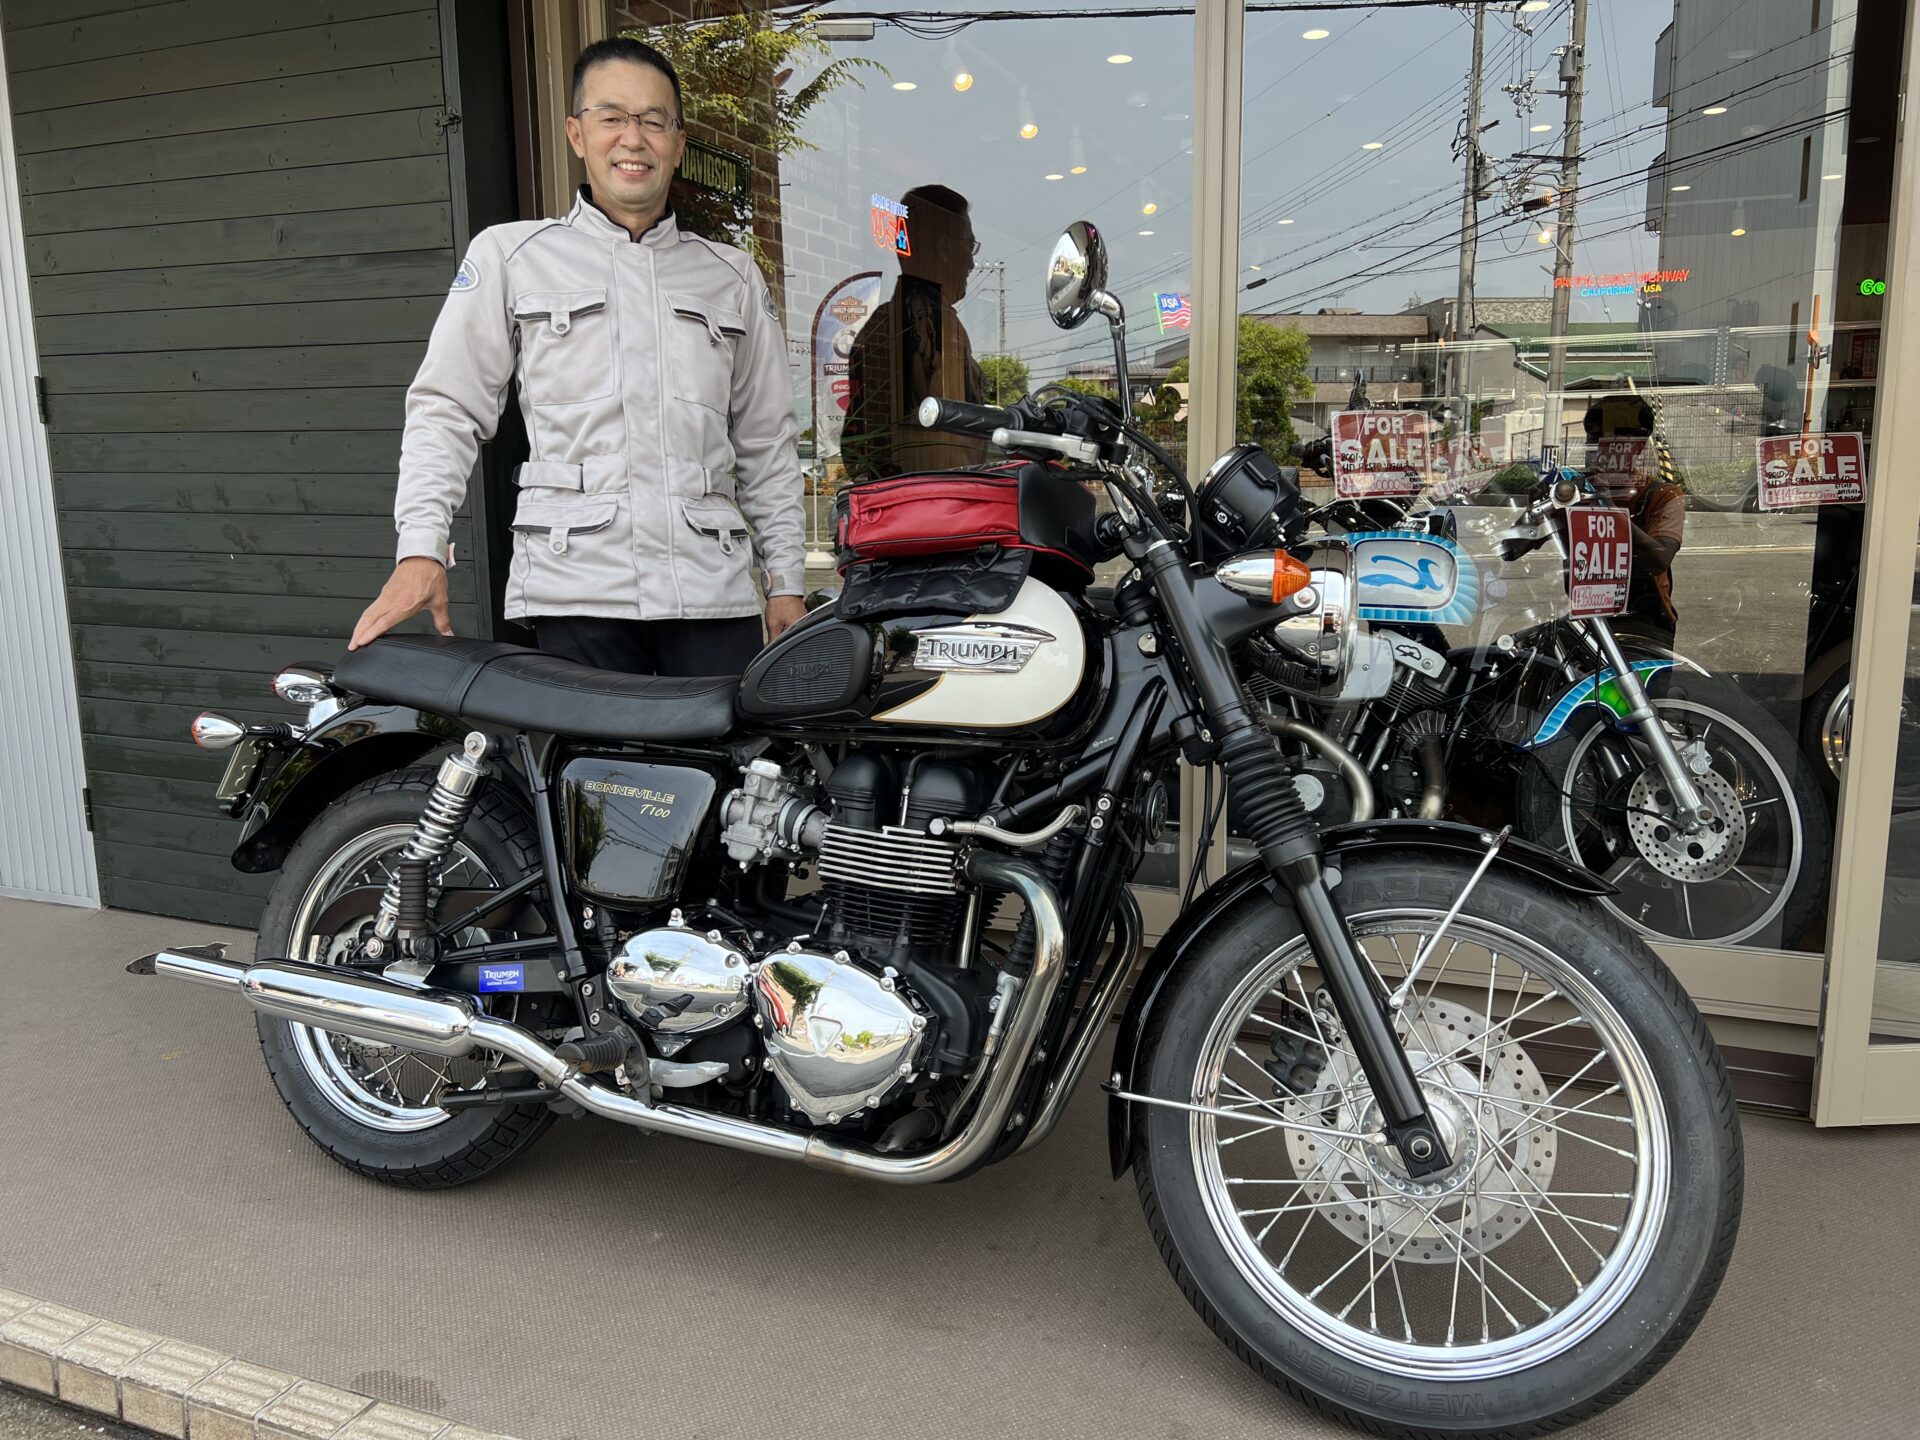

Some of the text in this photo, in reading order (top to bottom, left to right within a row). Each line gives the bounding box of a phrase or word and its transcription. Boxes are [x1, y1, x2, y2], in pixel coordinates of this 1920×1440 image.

[681, 146, 737, 196] DAVIDSON
[871, 207, 911, 256] USA
[1554, 269, 1690, 289] PACIFIC COAST HIGHWAY
[1581, 284, 1662, 297] CALIFORNIA USA
[1161, 297, 1179, 308] USA
[824, 364, 849, 374] TRIUM
[1363, 416, 1405, 435] FOR
[1340, 437, 1426, 471] SALE
[1608, 442, 1632, 454] FOR
[1789, 439, 1834, 457] FOR
[1765, 455, 1859, 485] SALE
[1588, 515, 1616, 538] FOR
[1574, 541, 1629, 581] SALE
[926, 638, 1019, 665] TRIUMPH
[584, 780, 675, 805] BONNEVILLE
[640, 803, 671, 818] T100
[484, 969, 520, 981] TRIUMPH
[1281, 1340, 1486, 1418] METZELER
